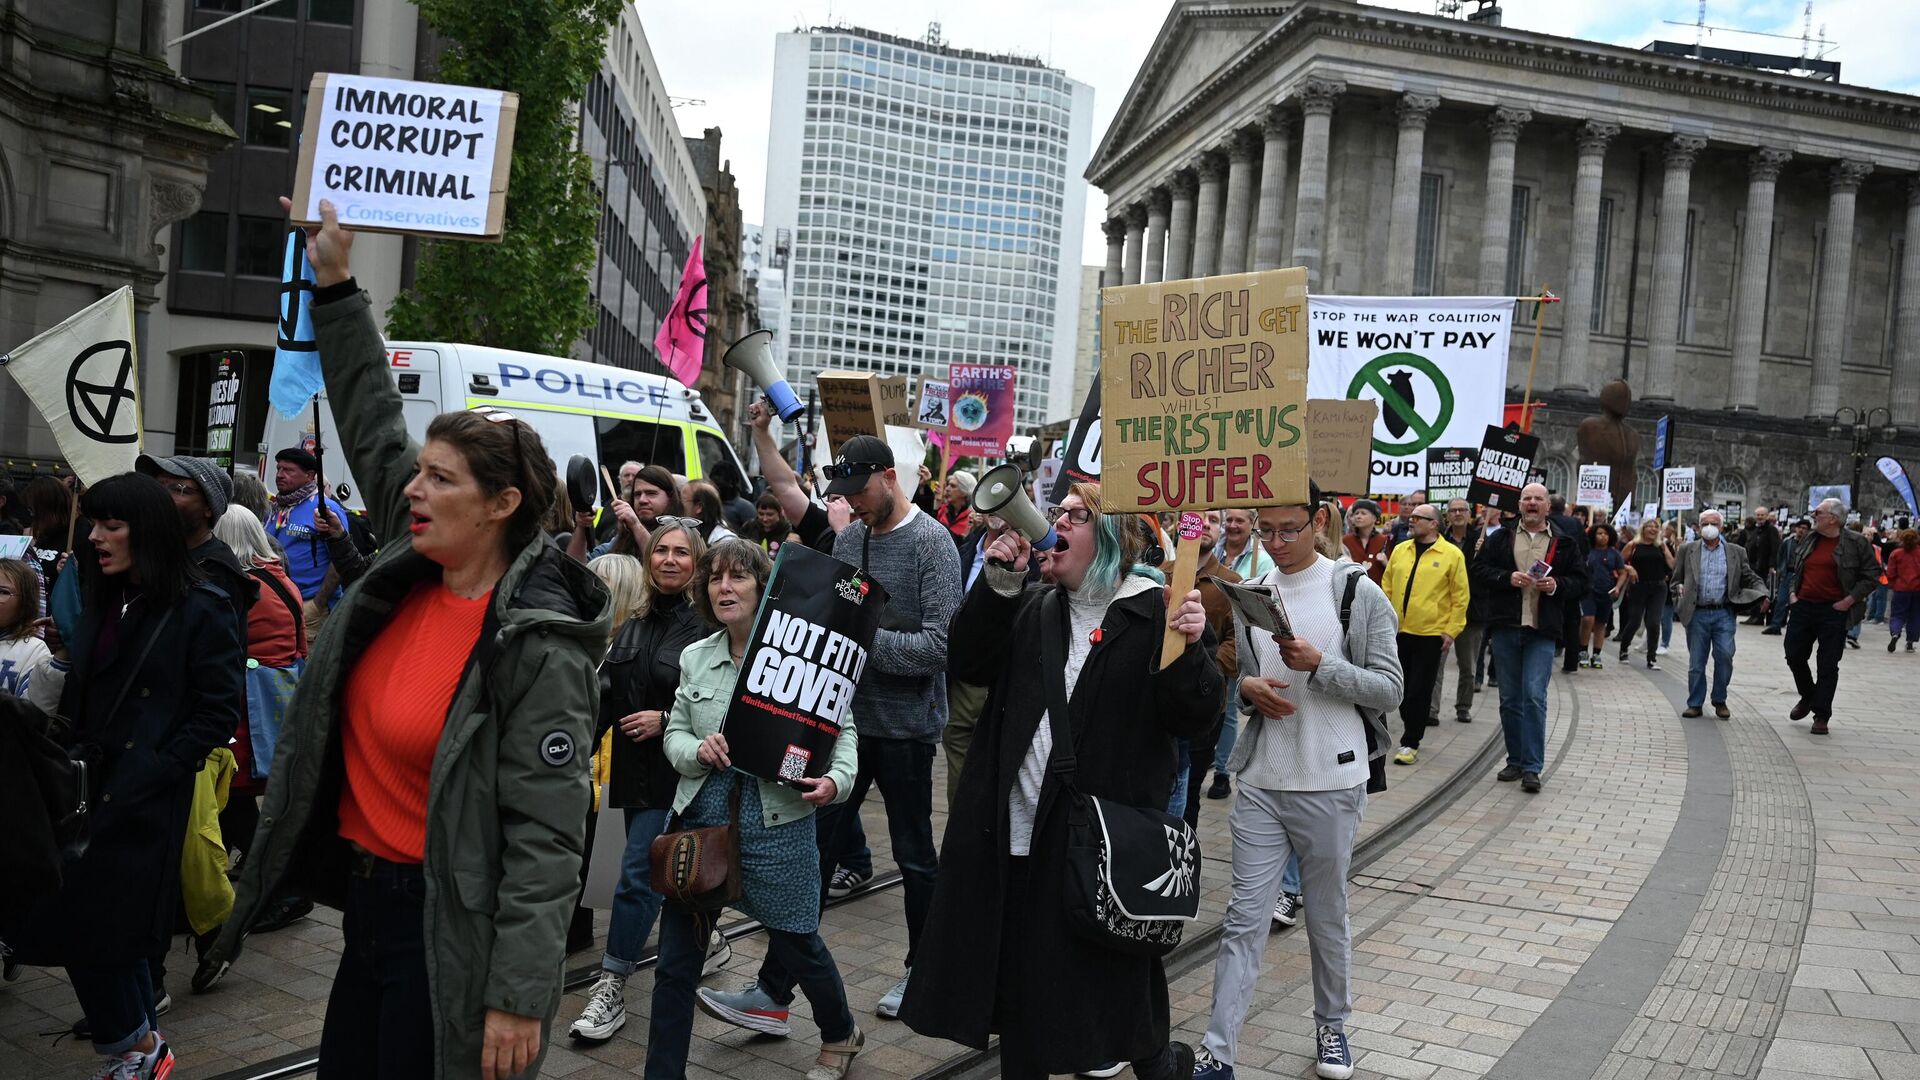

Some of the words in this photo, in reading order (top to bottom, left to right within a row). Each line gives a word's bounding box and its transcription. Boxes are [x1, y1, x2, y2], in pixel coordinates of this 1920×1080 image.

[335, 86, 484, 124] IMMORAL
[331, 120, 483, 160] CORRUPT
[325, 164, 475, 201] CRIMINAL
[346, 204, 480, 228] Conservatives
[1114, 318, 1158, 344] THE
[1163, 289, 1250, 343] RICH
[1259, 305, 1301, 334] GET
[1313, 311, 1346, 321] STOP
[1354, 313, 1377, 323] THE
[1386, 314, 1418, 323] WAR
[1428, 313, 1501, 323] COALITION
[1317, 330, 1348, 348] WE
[1357, 330, 1435, 350] WON'T
[1443, 331, 1496, 349] PAY
[951, 366, 1012, 380] EARTH'S
[1130, 341, 1275, 399] RICHER
[498, 362, 673, 409] POLICE
[881, 384, 906, 400] DUMP
[951, 378, 971, 389] ON
[975, 379, 1005, 390] FIRE
[1160, 396, 1222, 414] WHILST
[1115, 415, 1161, 443] THE
[1163, 411, 1233, 456] REST
[1235, 408, 1254, 434] OF
[1256, 404, 1301, 448] US
[1430, 462, 1460, 475] WAGES
[1461, 460, 1474, 474] UP
[1480, 447, 1502, 464] NOT
[1500, 453, 1517, 468] FIT
[1516, 457, 1530, 471] TO
[1136, 454, 1274, 508] SUFFER
[1429, 475, 1450, 487] BILLS
[1476, 460, 1527, 489] GOVERN
[1430, 488, 1457, 500] TORIES
[1581, 481, 1605, 489] OUT!
[288, 523, 310, 533] Unite
[1180, 522, 1203, 531] school
[1183, 514, 1201, 524] Stop
[762, 609, 826, 660] NOT
[820, 630, 858, 675] FIT
[747, 646, 857, 727] GOVER
[549, 743, 569, 754] DLX
[789, 745, 809, 758] DONATE
